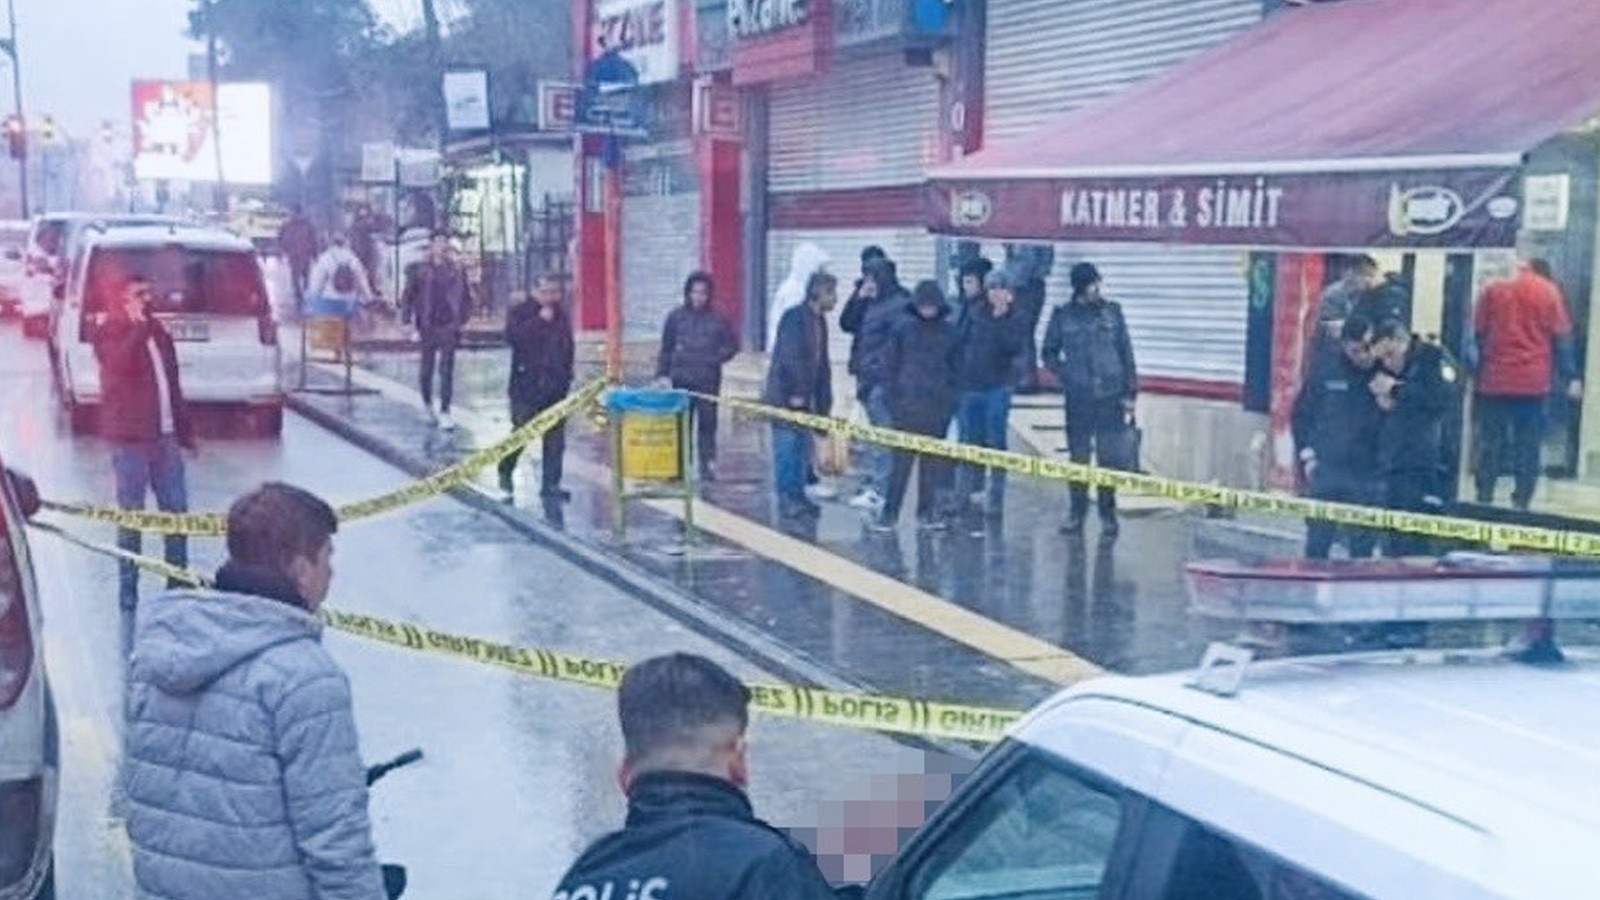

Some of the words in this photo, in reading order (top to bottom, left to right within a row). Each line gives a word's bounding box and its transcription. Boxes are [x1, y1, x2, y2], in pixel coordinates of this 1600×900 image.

[1060, 190, 1158, 228] KATMER
[1169, 187, 1187, 227] &
[1197, 176, 1283, 228] SİMİT
